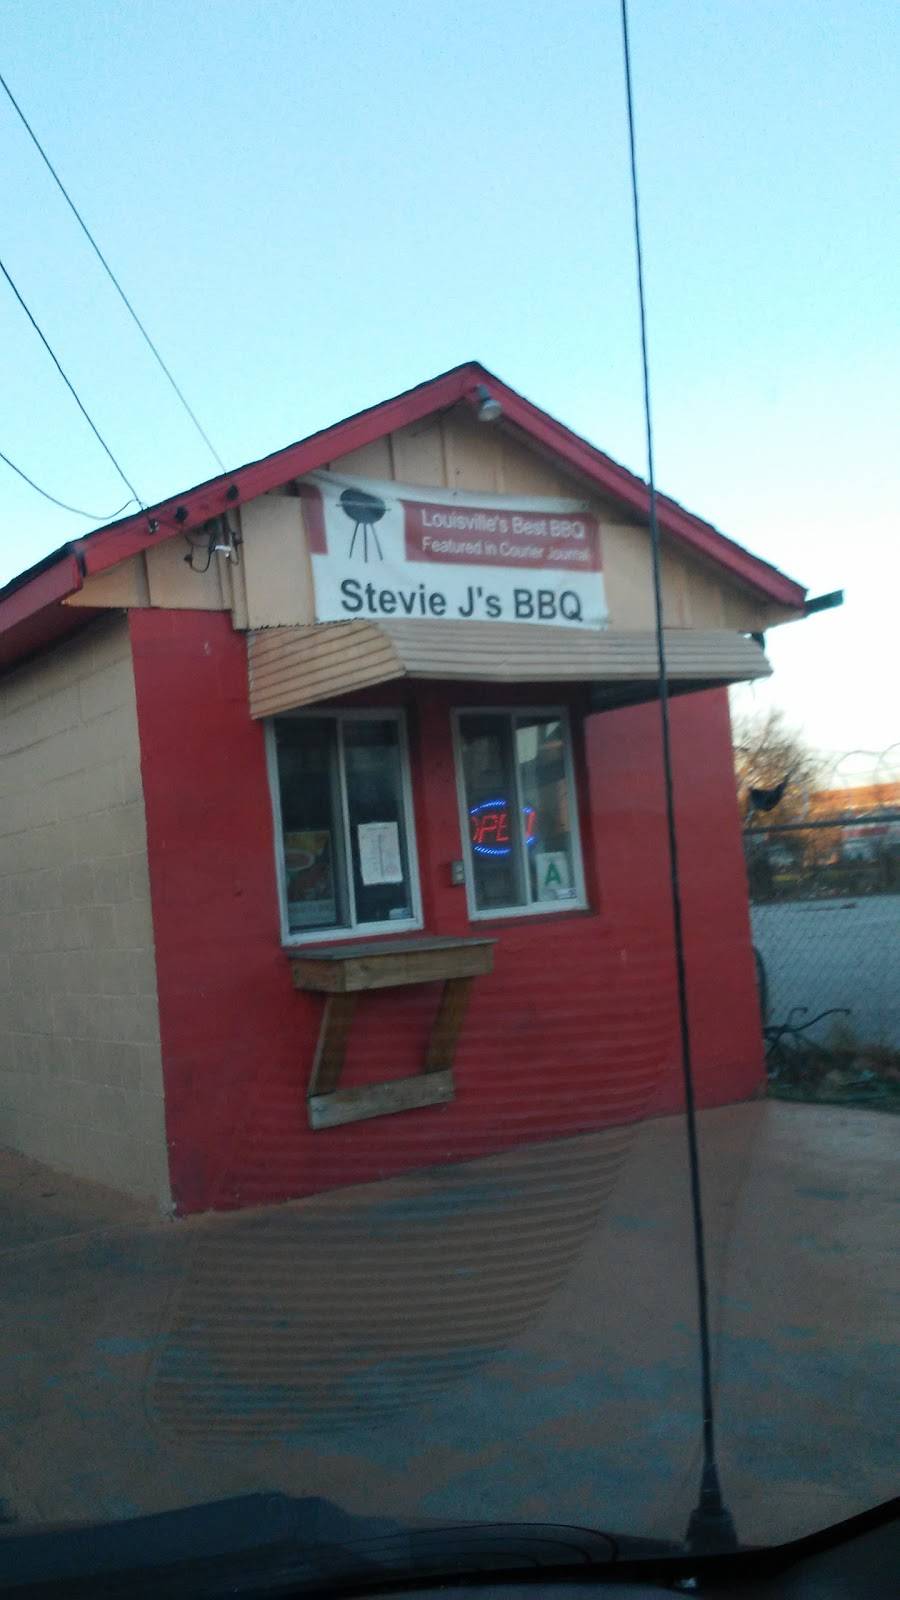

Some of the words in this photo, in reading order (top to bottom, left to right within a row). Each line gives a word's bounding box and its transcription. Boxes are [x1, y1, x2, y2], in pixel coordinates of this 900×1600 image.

[421, 508, 509, 534] Louisville's
[511, 516, 546, 537] Best
[550, 519, 585, 539] BBQ
[421, 536, 482, 556] Featured
[483, 541, 498, 556] in
[499, 541, 545, 559] Courier
[547, 546, 590, 561] Journal
[340, 579, 447, 616] Stevie
[458, 586, 503, 618] J's
[513, 588, 584, 622] BBQ
[544, 862, 562, 887] A
